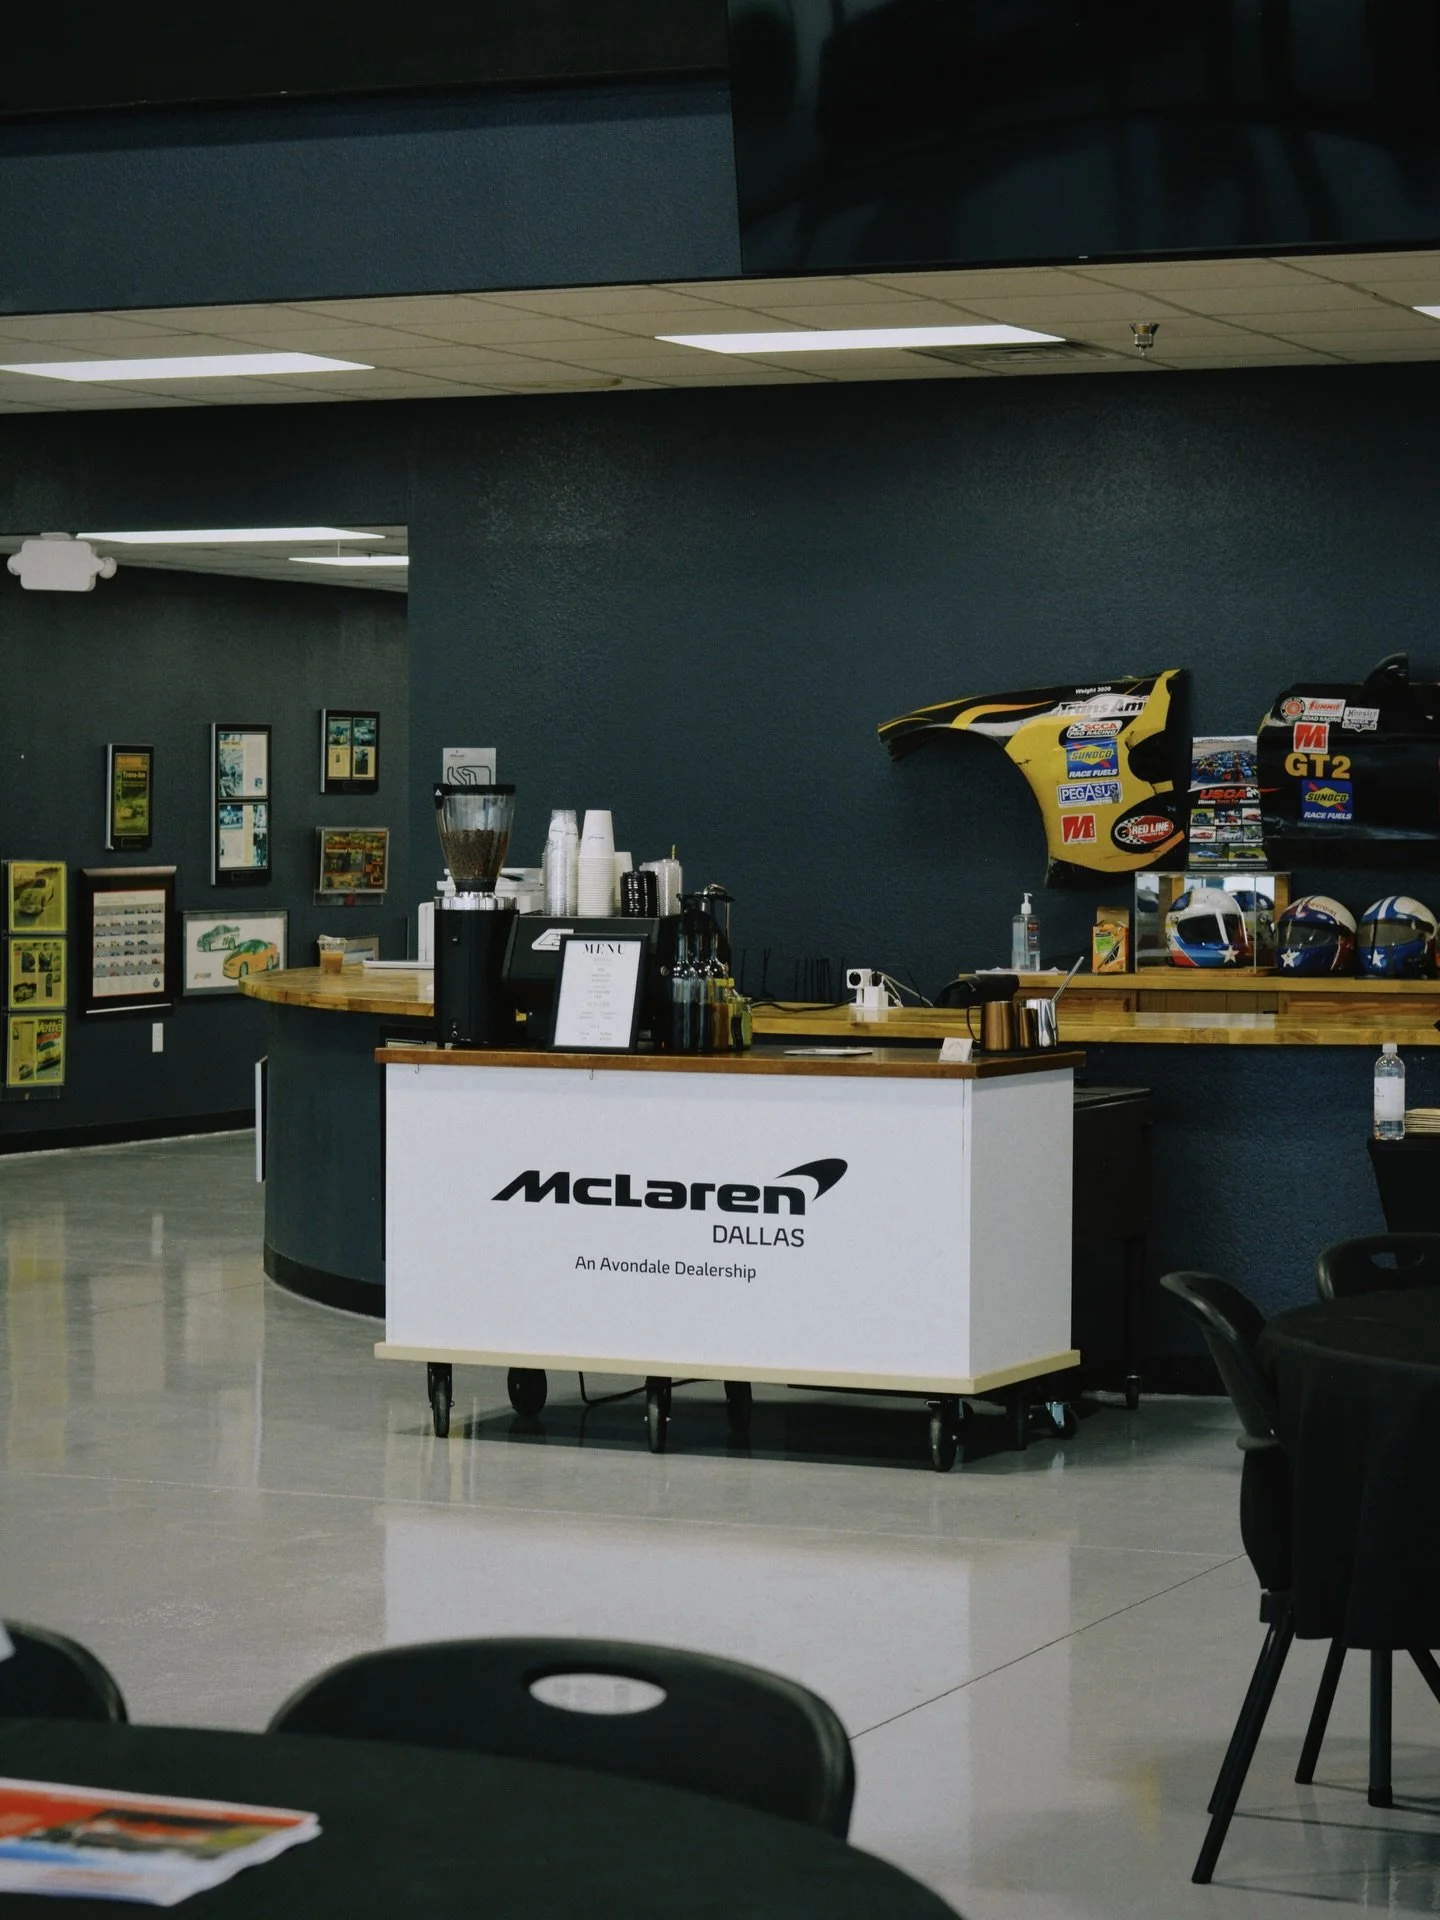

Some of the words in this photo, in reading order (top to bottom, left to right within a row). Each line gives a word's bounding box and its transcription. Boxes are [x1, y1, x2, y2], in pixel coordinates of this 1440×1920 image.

[1084, 723, 1117, 731] SCCA
[1086, 729, 1117, 737] RACING
[1071, 750, 1112, 761] SUNOCO
[1284, 752, 1352, 779] GT2
[1069, 770, 1091, 778] RACE
[1092, 768, 1118, 777] FUELS
[1061, 784, 1118, 801] PEGASUS
[1306, 792, 1348, 802] SUNOCO
[1304, 810, 1327, 819] RACE
[1327, 810, 1352, 820] FUELS
[1131, 824, 1149, 835] RED
[1150, 821, 1169, 833] LINE
[583, 943, 626, 955] MENU
[491, 1169, 806, 1215] McLaren
[712, 1225, 805, 1248] DALLAS
[575, 1256, 596, 1271] An
[599, 1257, 670, 1276] Avondale
[674, 1260, 757, 1283] Dealership
